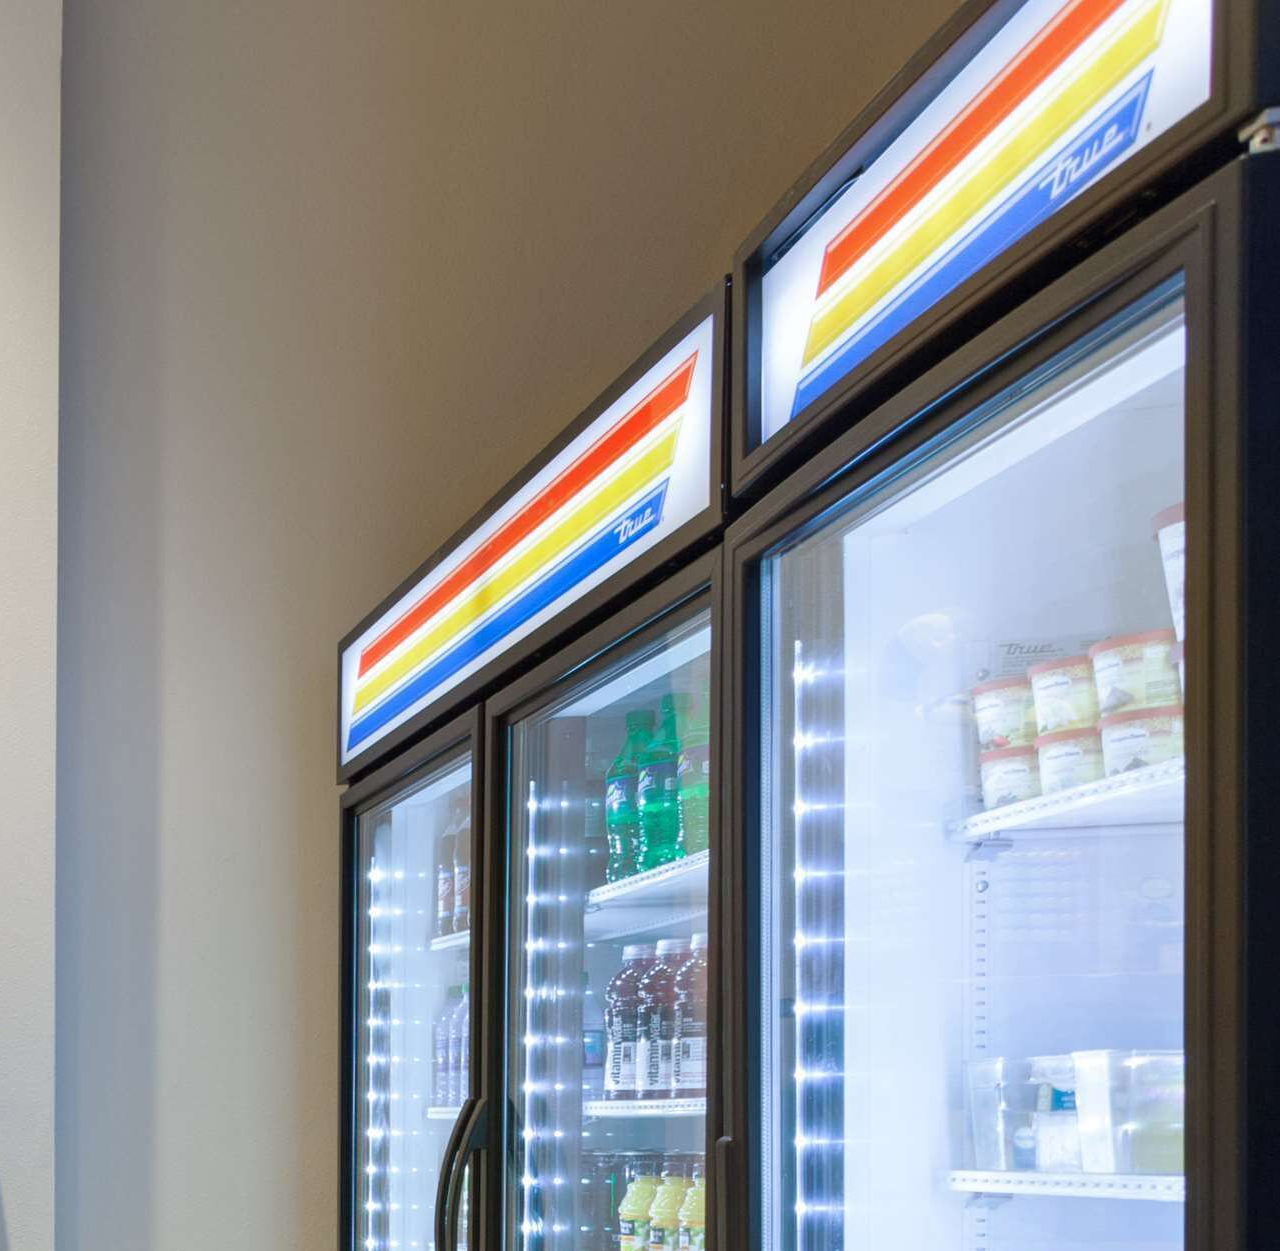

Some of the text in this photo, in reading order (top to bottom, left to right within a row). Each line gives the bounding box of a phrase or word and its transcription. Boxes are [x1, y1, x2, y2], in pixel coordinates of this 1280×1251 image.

[1038, 124, 1126, 200] True
[613, 507, 655, 544] True
[611, 1014, 623, 1085] vitaminwater
[647, 1013, 661, 1086] vitaminwater
